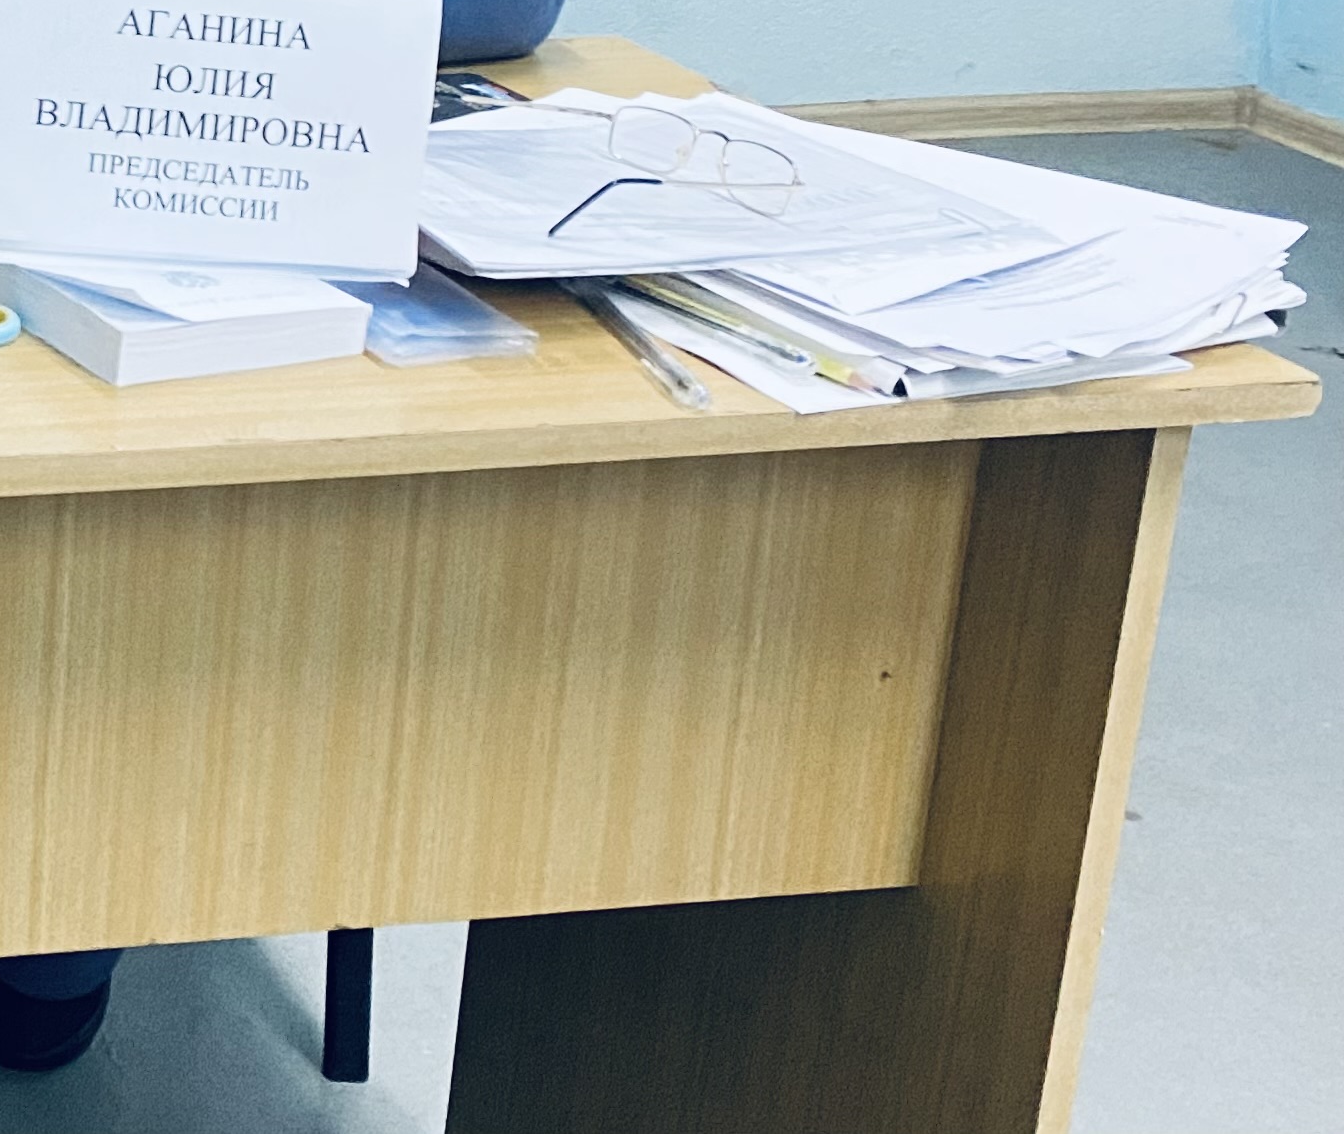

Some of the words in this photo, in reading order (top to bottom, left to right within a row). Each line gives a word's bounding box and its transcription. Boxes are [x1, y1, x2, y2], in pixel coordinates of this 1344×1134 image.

[117, 9, 312, 50] АГАНИНА
[153, 63, 276, 101] ЮЛИЯ
[34, 98, 372, 154] ВЛАДИМИРОВНА
[87, 152, 311, 192] ПРЕДСЕДАТЕЛЬ
[112, 187, 280, 222] КОМИССИИ
